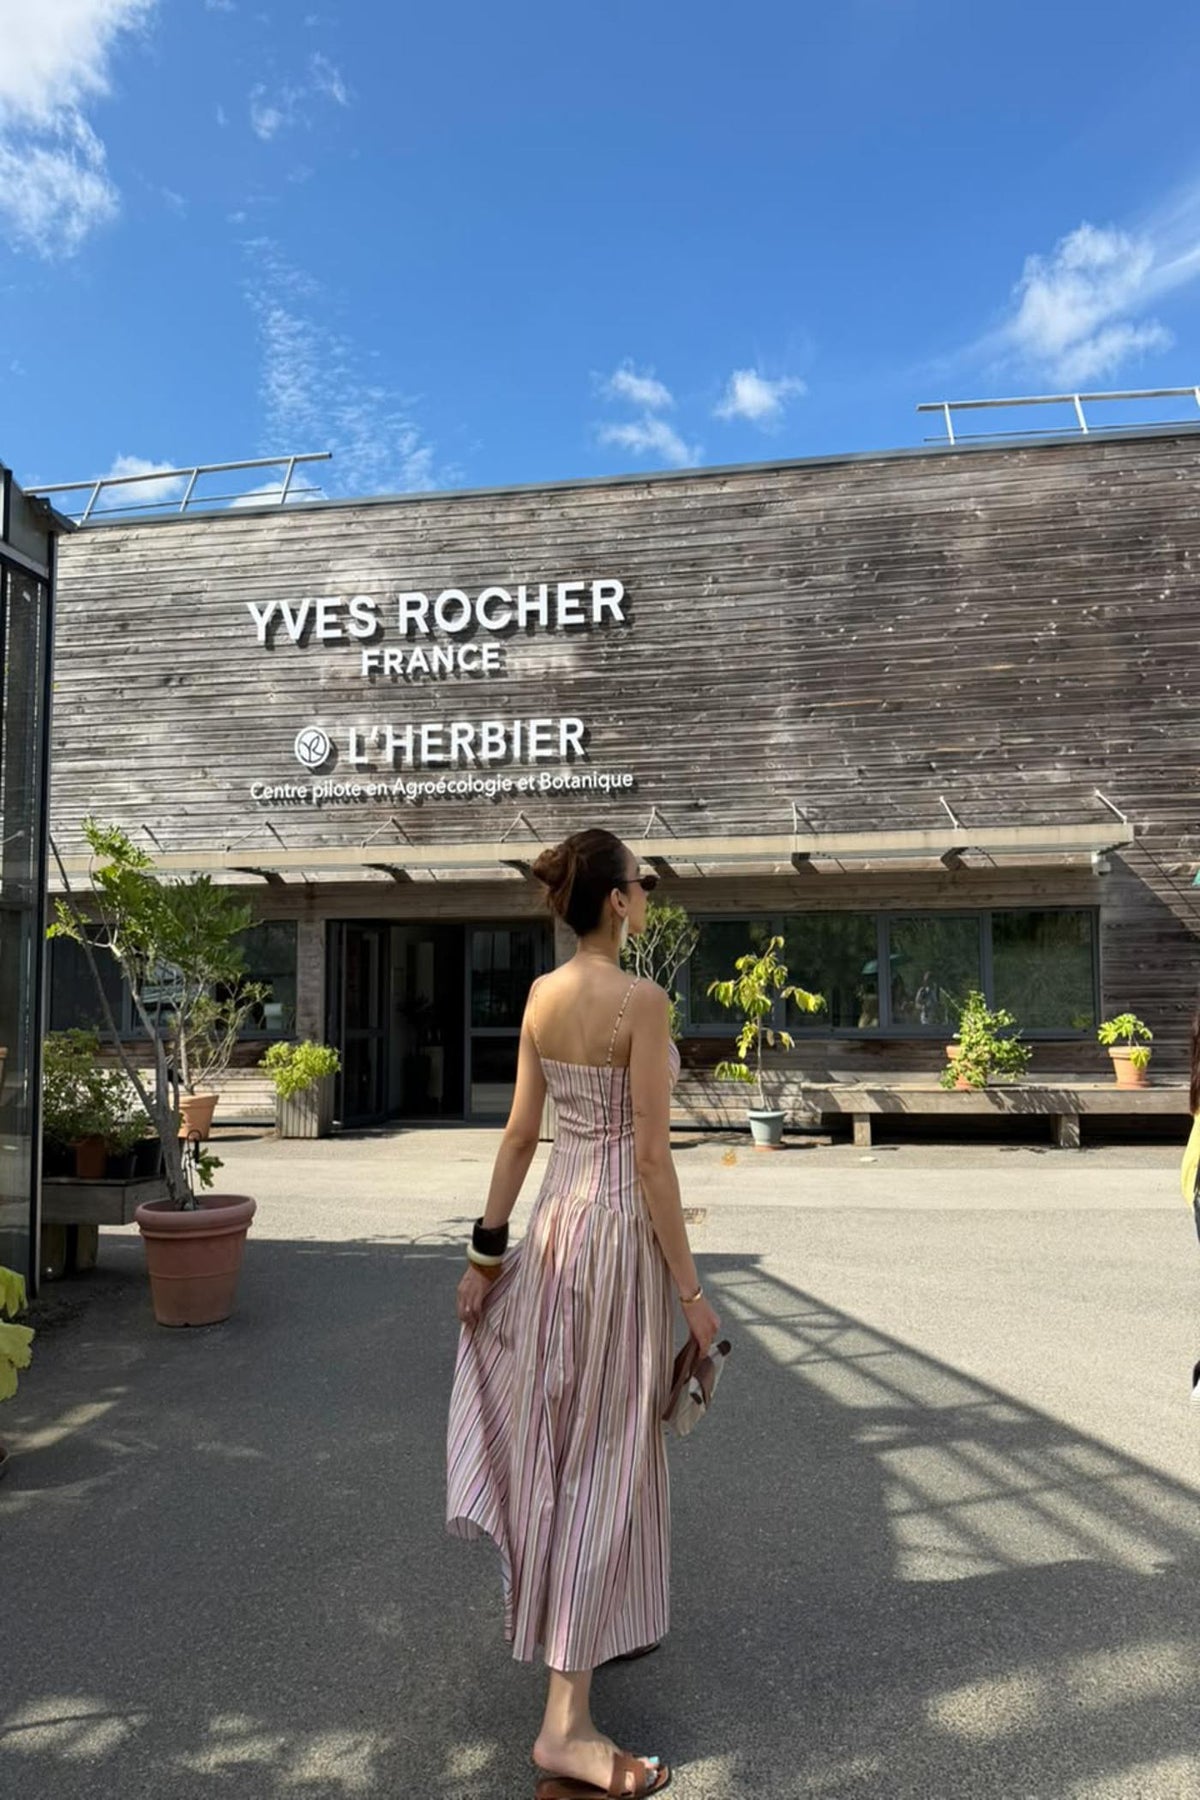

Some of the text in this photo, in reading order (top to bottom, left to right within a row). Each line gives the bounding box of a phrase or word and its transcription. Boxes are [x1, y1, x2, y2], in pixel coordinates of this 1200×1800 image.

[247, 579, 625, 642] YVES ROCHER
[361, 642, 500, 676] FRANCE
[250, 771, 633, 803] Centre pilote en Agroécologie et Botanique
